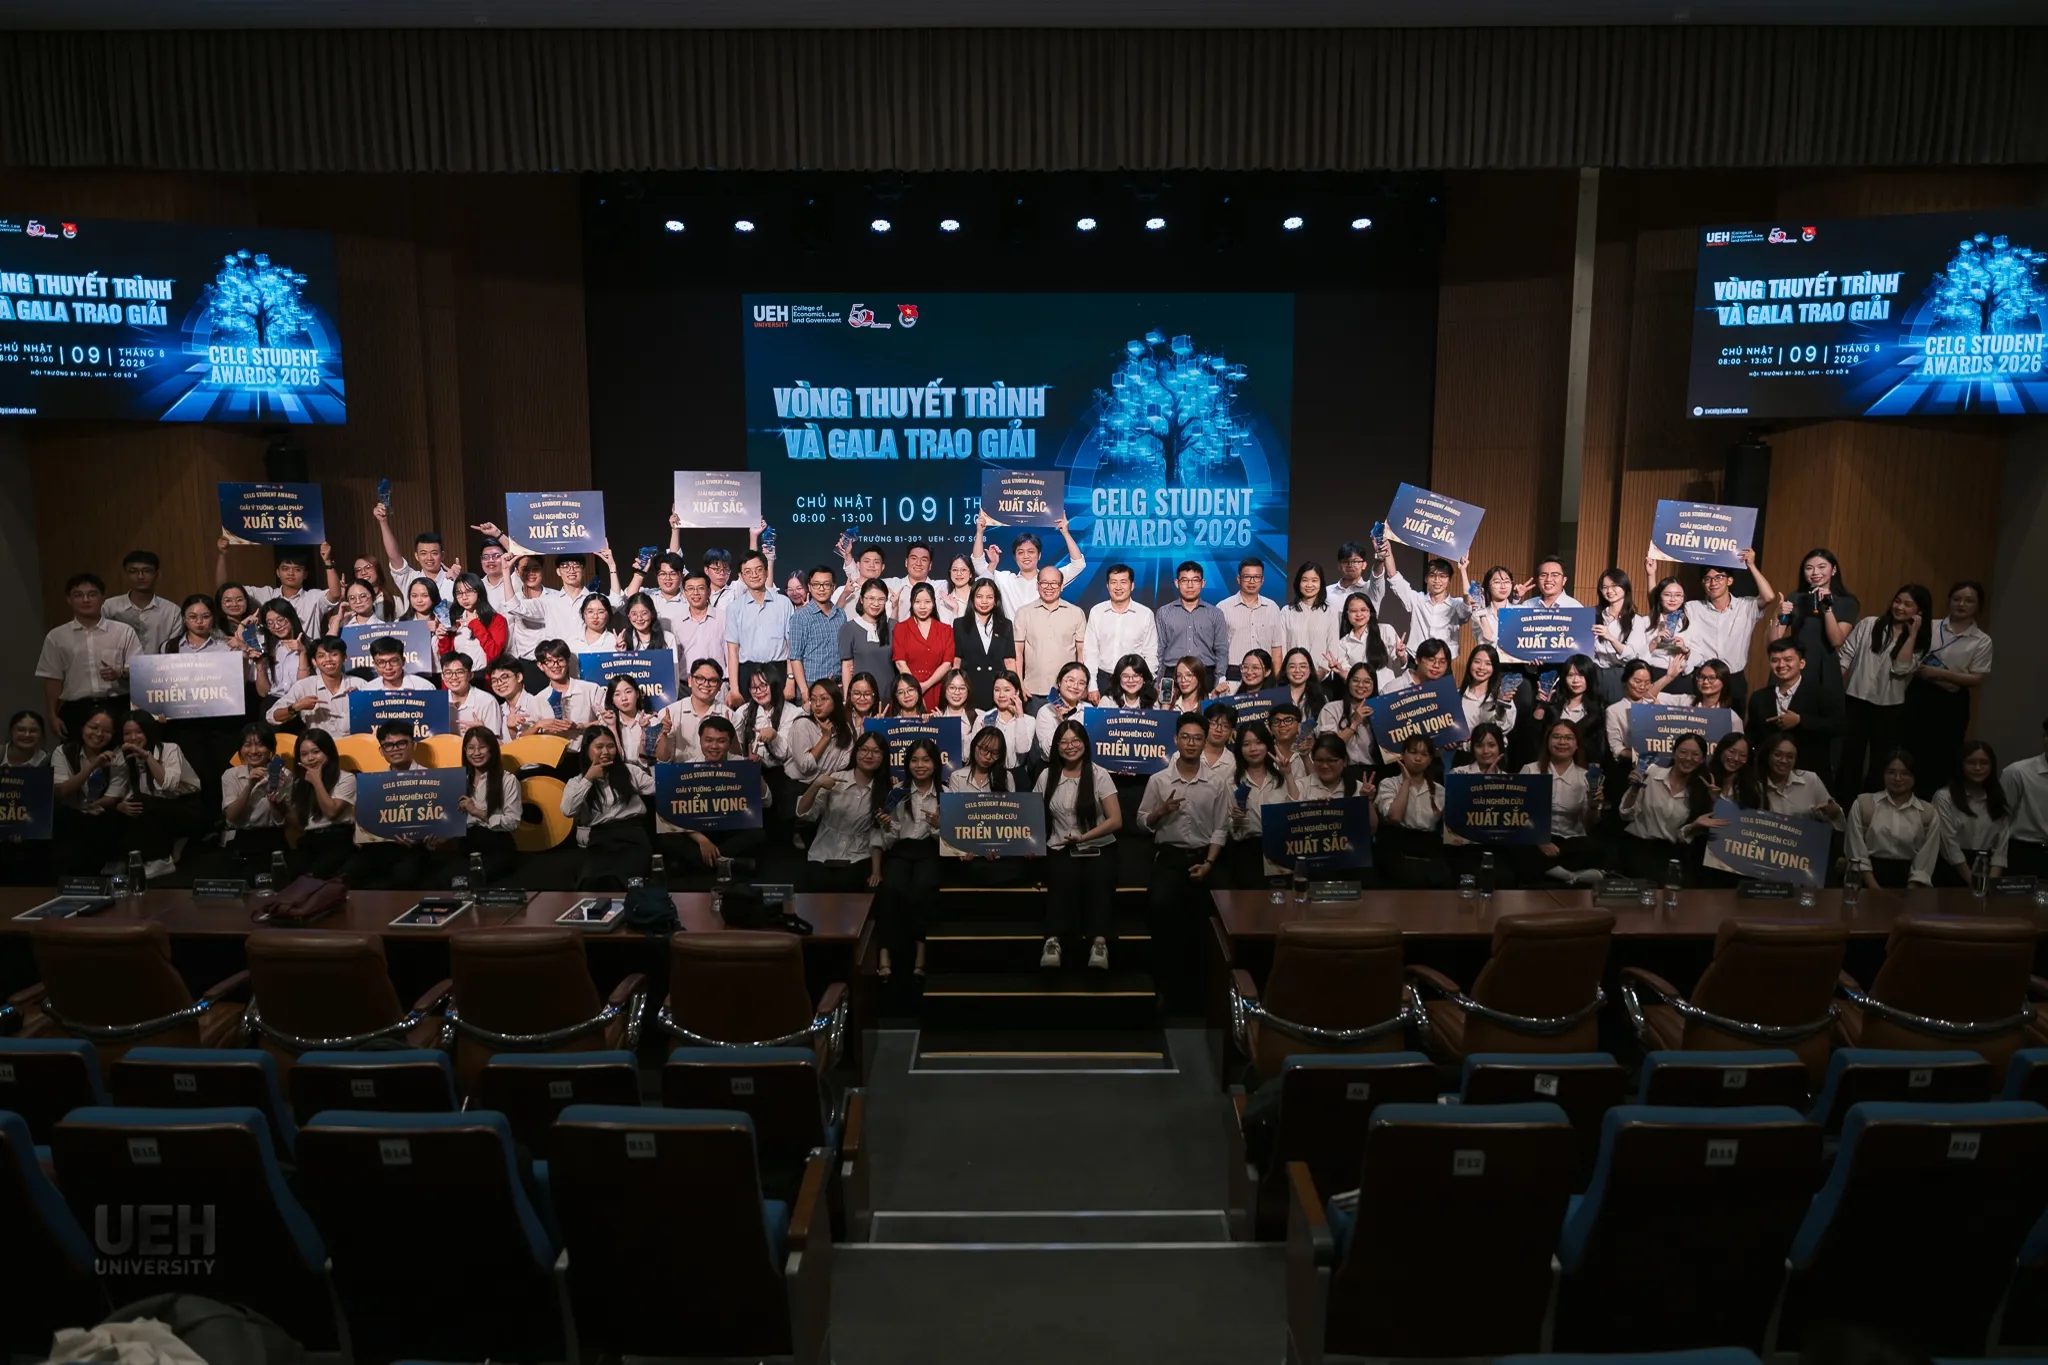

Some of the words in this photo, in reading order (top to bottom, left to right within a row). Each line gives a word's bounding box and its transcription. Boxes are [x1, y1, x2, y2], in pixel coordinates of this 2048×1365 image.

[1706, 231, 1730, 243] UEH
[0, 272, 34, 294] NG
[36, 271, 108, 297] THUYẾT
[113, 275, 172, 299] TRÌNH
[1714, 277, 1766, 301] VÒNG
[1768, 271, 1837, 298] THUYẾT
[1841, 271, 1900, 296] TRÌNH
[17, 300, 69, 323] GALA
[73, 303, 122, 324] TRAO
[126, 300, 167, 325] GIẢI
[753, 305, 789, 322] UEH
[1718, 301, 1745, 326] VÀ
[1747, 303, 1793, 325] GALA
[1798, 302, 1846, 323] TRAO
[1849, 295, 1890, 321] GIẢI
[24, 342, 52, 355] NHẬT
[72, 346, 100, 364] 09
[119, 346, 155, 358] THÁNG
[160, 349, 165, 358] 8
[1722, 345, 1742, 356] CHỦ
[1746, 345, 1774, 357] NHẬT
[1789, 345, 1817, 363] 09
[1835, 342, 1870, 353] THÁNG
[1874, 344, 1880, 352] 8
[1926, 336, 1966, 356] CELG
[1971, 334, 2045, 354] STUDENT
[30, 355, 54, 363] 13:00
[120, 359, 145, 367] 2026
[209, 346, 248, 365] CELG
[252, 348, 319, 368] STUDENT
[1834, 355, 1859, 364] 2026
[1923, 355, 1993, 375] AWARDS
[1999, 354, 2042, 374] 2026
[211, 365, 277, 384] AWARDS
[281, 368, 320, 386] 2026
[773, 380, 852, 418] VÒNG
[856, 378, 956, 418] THUYẾT
[961, 380, 1045, 418] TRÌNH
[785, 422, 826, 460] VÀ
[828, 428, 898, 460] GALA
[904, 428, 973, 460] TRAO
[979, 419, 1035, 460] GIẢI
[693, 498, 720, 513] XUẤT
[723, 498, 744, 513] SẮC
[796, 493, 827, 508] CHỦ
[834, 494, 873, 510] NHẬT
[899, 496, 937, 522] 09
[998, 500, 1025, 513] XUẤT
[1027, 498, 1047, 513] SẮC
[1091, 489, 1146, 517] CELG
[1155, 488, 1254, 517] STUDENT
[243, 512, 275, 529] XUẤT
[279, 511, 303, 529] SẮC
[792, 514, 826, 523] 08:00
[842, 513, 874, 523] 13:00
[529, 521, 559, 539] XUẤT
[562, 519, 585, 538] SẮC
[859, 534, 892, 543] TRƯỜNG
[928, 535, 944, 543] UEH
[954, 535, 966, 543] CƠ
[1092, 519, 1187, 547] AWARDS
[1194, 519, 1251, 547] 2026
[1403, 517, 1431, 536] XUẤT
[1431, 525, 1455, 544] SẮC
[1666, 530, 1701, 549] TRIỂN
[1704, 537, 1737, 552] VỌNG
[1517, 632, 1548, 649] XUẤT
[1550, 631, 1575, 649] SẮC
[146, 684, 186, 704] TRIỂN
[190, 686, 229, 703] VỌNG
[413, 719, 430, 738] ẮC
[1388, 719, 1422, 744] TRIỂN
[1423, 712, 1454, 734] VỌNG
[1096, 738, 1130, 756] TRIỂN
[1134, 742, 1166, 760] VỌNG
[1645, 734, 1675, 753] TRIỂ
[399, 792, 423, 801] NGHIÊN
[671, 793, 710, 815] TRIỂN
[713, 796, 748, 815] VỌNG
[379, 804, 413, 823] XUẤT
[417, 801, 444, 821] SẮC
[981, 813, 1004, 821] NGHIÊN
[1466, 806, 1500, 826] XUẤT
[1503, 806, 1530, 827] SẮC
[954, 820, 993, 840] TRIỂN
[996, 826, 1031, 842] VỌNG
[1285, 836, 1318, 856] XUẤT
[1322, 832, 1349, 852] SẮC
[1724, 838, 1765, 861] TRIỂN
[1769, 849, 1810, 870] VỌNG
